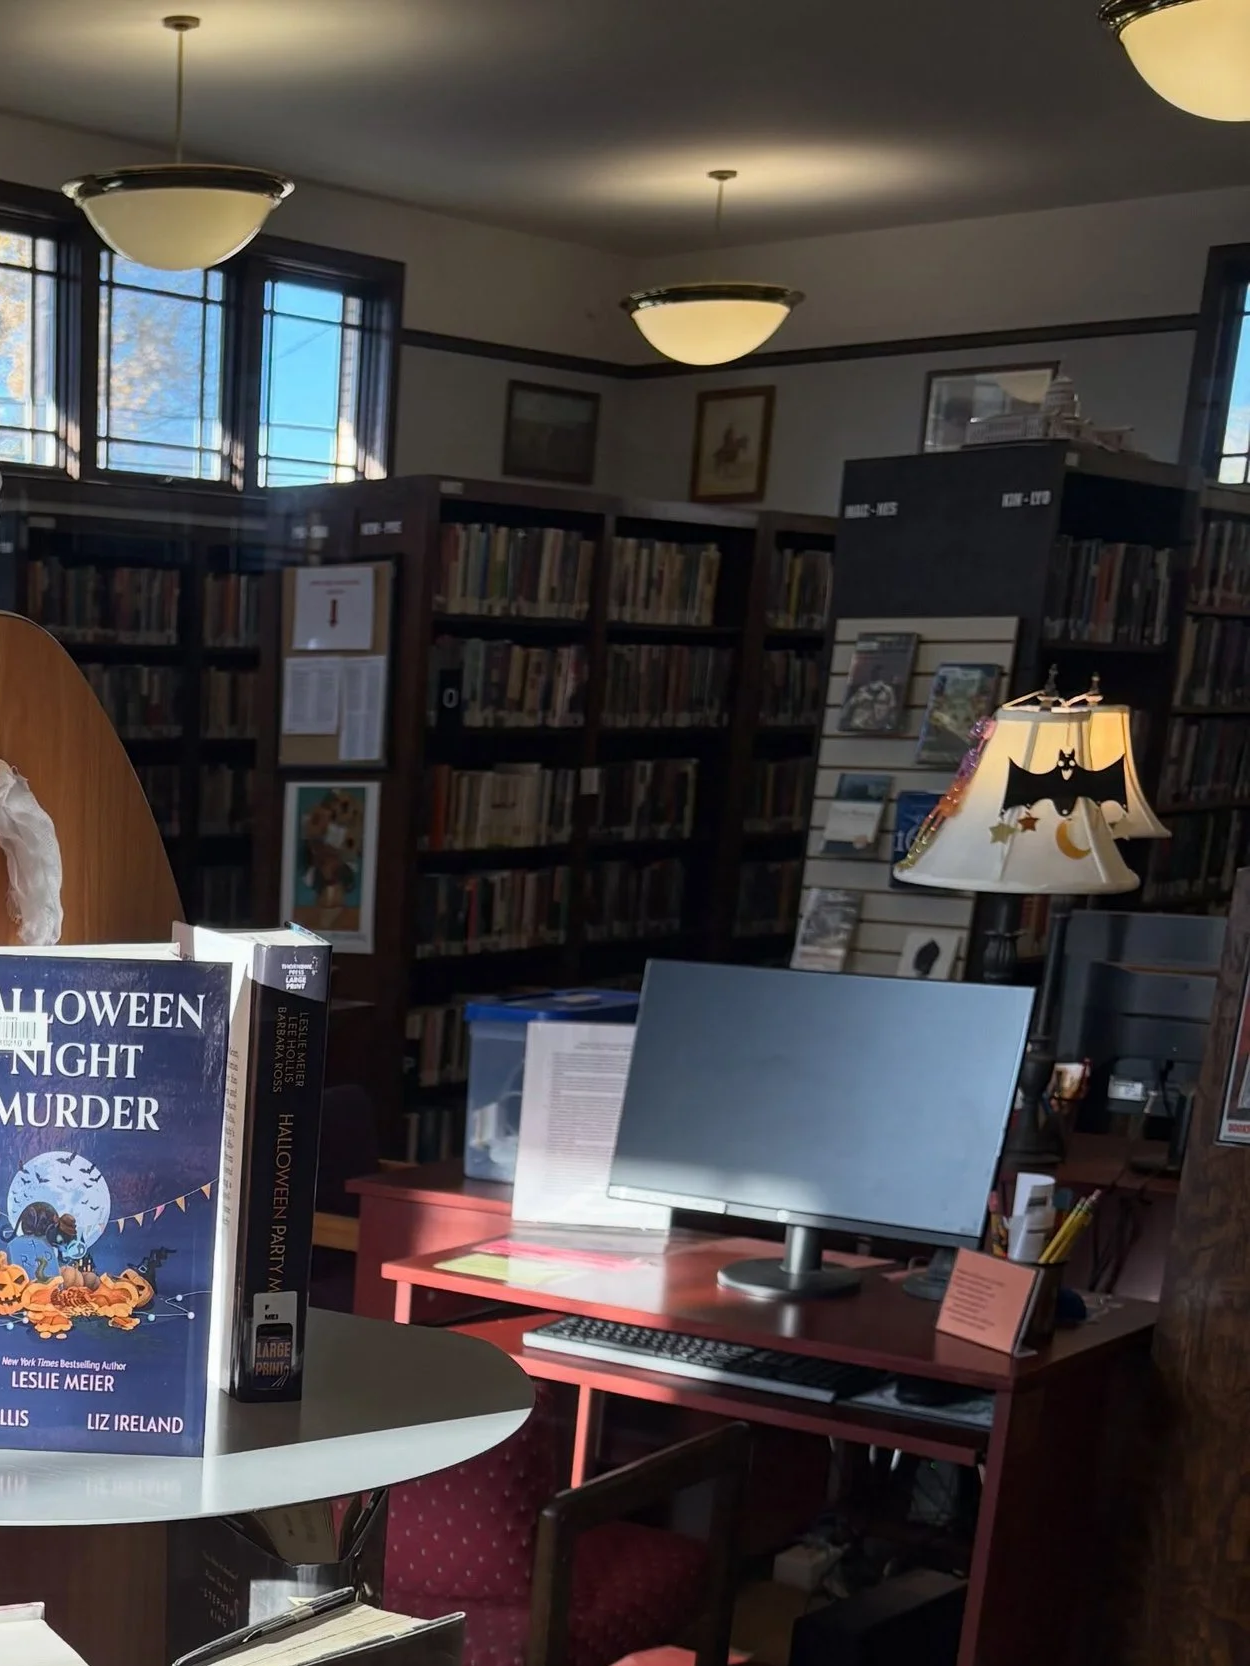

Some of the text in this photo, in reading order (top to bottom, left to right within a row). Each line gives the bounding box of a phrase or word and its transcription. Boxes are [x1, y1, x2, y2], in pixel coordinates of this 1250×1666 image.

[285, 976, 307, 984] LARGE
[10, 1043, 145, 1080] NIGHT
[273, 1006, 287, 1093] BARBARA ROSS
[284, 1016, 297, 1083] LEE HOLLIS
[295, 1012, 309, 1087] LESLIE MEIER
[272, 1113, 295, 1220] HALLOWEEN
[268, 1224, 287, 1277] PARTY
[2, 1356, 127, 1371] New York Times Bestselling Author
[256, 1341, 292, 1359] LARGE
[11, 1370, 115, 1392] LESLIE MEIER
[254, 1360, 285, 1376] PRINT
[87, 1413, 184, 1434] LIZ IRELAND
